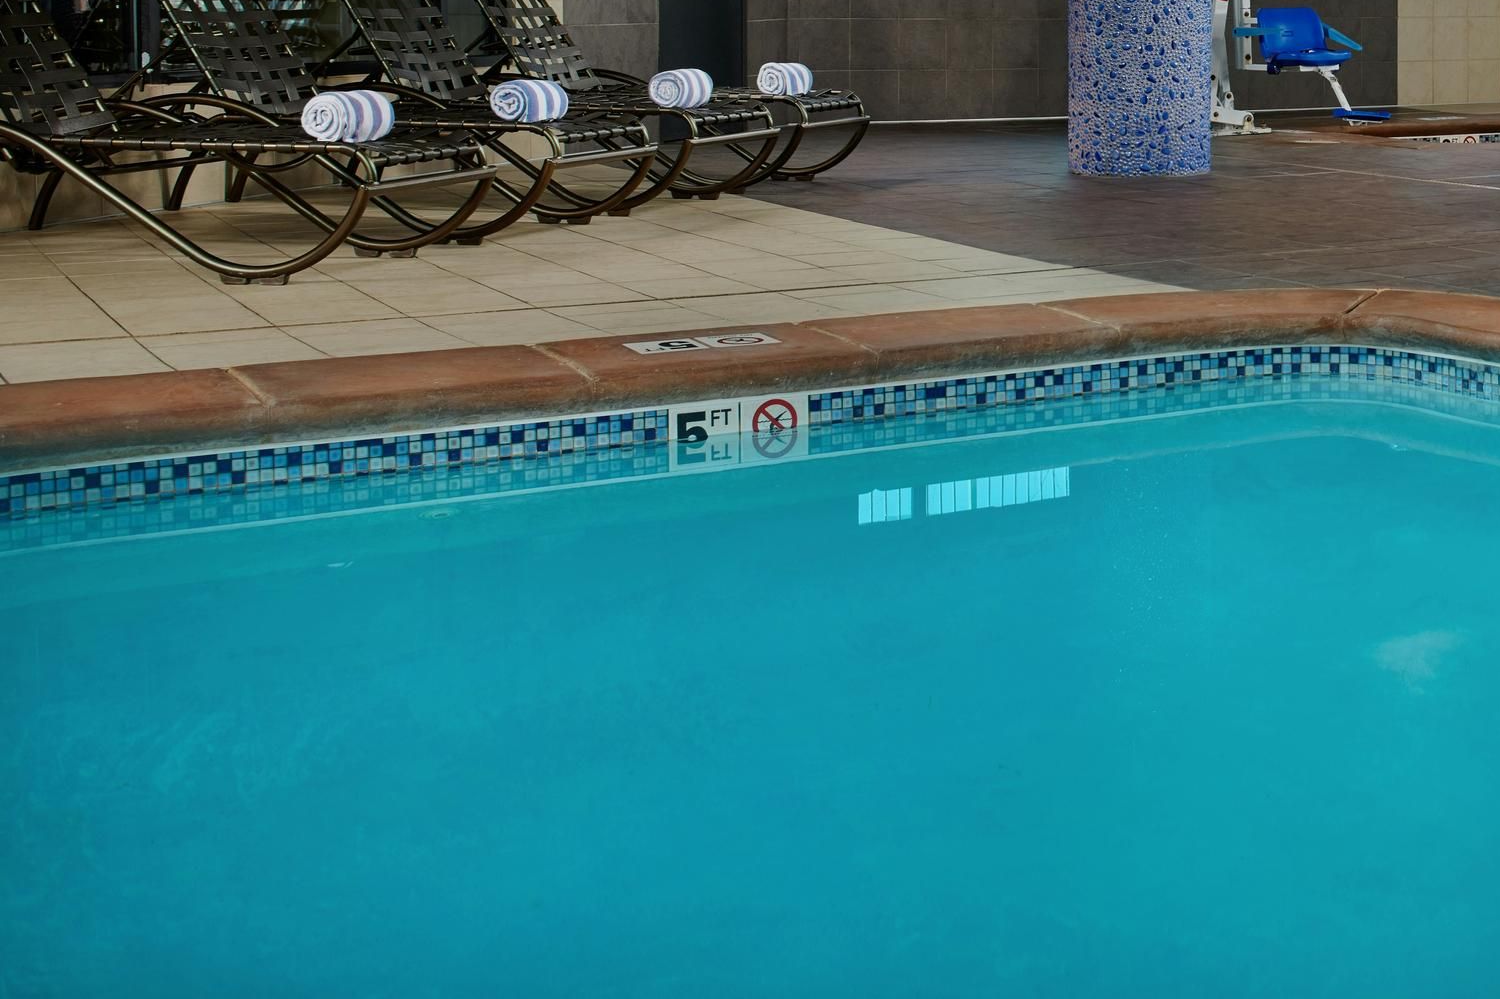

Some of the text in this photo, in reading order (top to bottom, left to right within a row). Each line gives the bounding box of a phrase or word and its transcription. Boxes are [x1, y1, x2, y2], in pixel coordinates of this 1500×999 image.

[658, 341, 698, 350] 5
[677, 408, 732, 442] 5 FT
